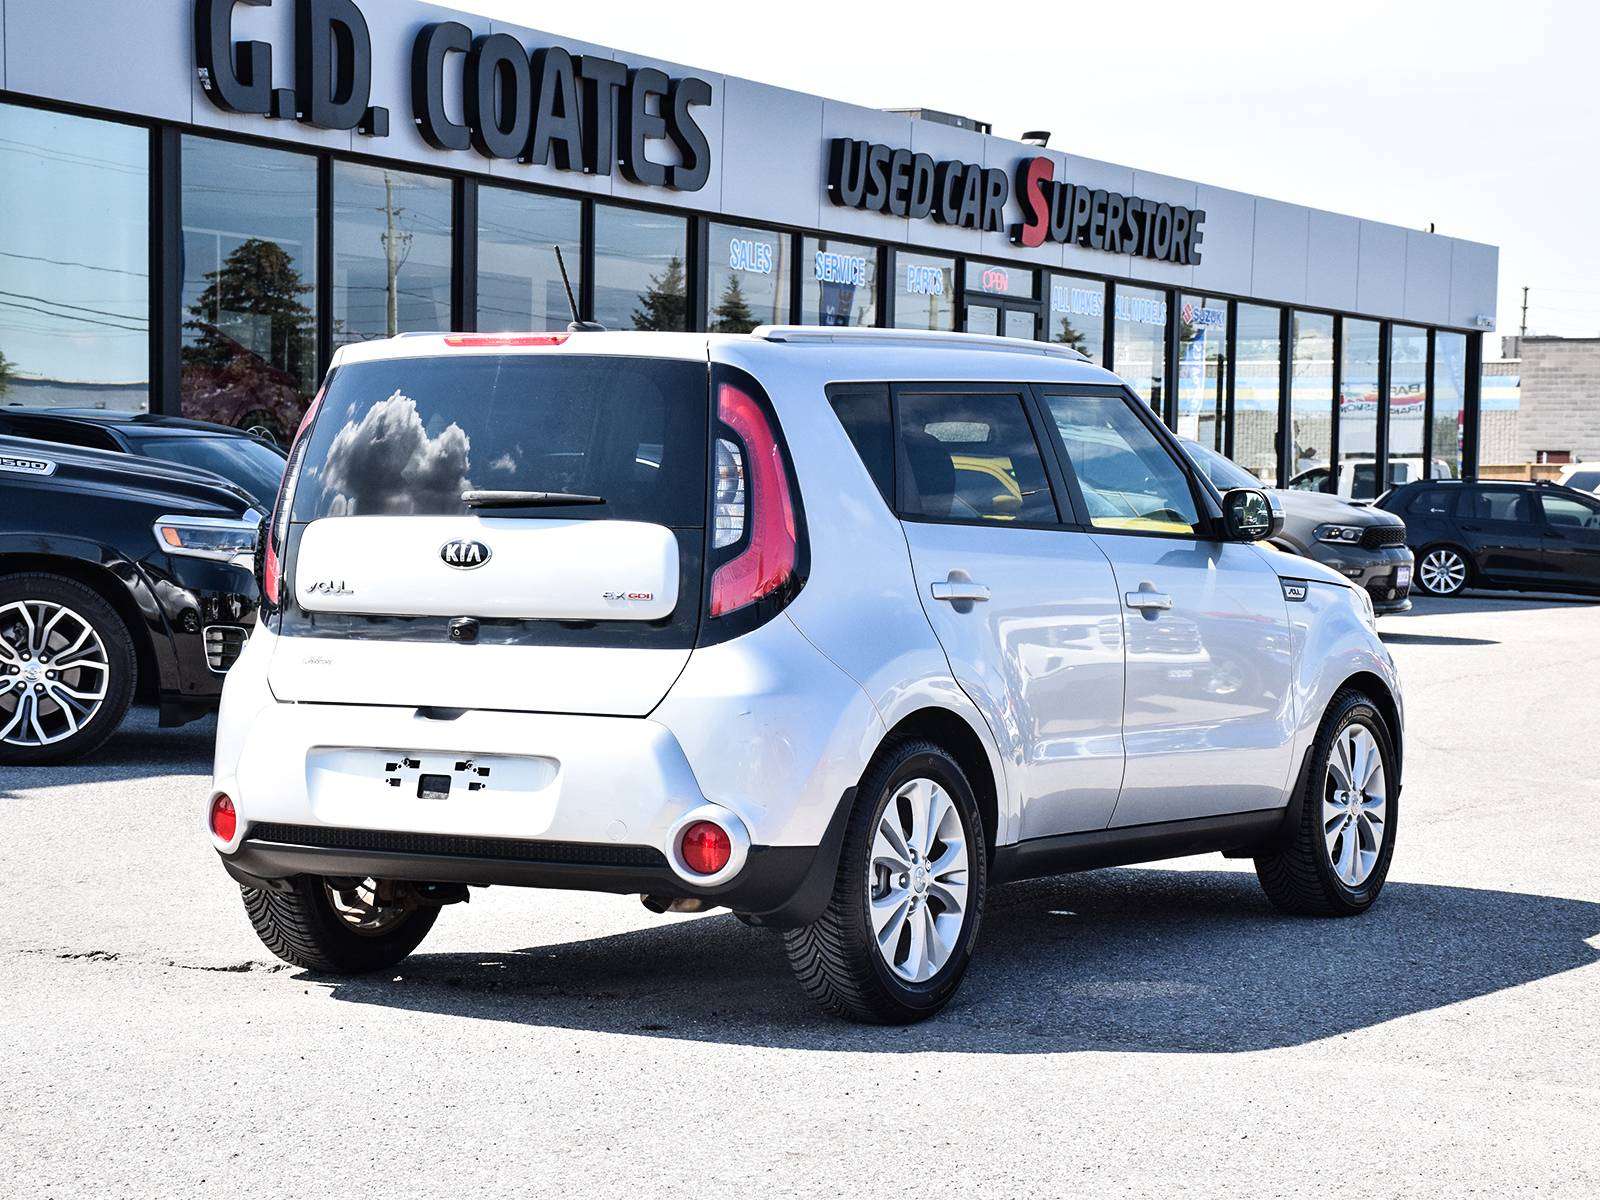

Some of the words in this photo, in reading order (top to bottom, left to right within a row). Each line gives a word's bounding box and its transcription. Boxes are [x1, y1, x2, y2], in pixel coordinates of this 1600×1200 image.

[413, 21, 712, 192] COATES
[829, 137, 935, 220] USED
[934, 160, 1009, 232] CAR
[1012, 156, 1206, 266] SUPERSTORE
[730, 238, 772, 274] SALES
[815, 251, 866, 287] SERVICE
[906, 265, 943, 296] PARTS
[982, 271, 1008, 291] OPEN
[1052, 286, 1071, 312] ALL
[1071, 288, 1102, 317] MAKES
[1114, 294, 1131, 320] ALL
[1131, 297, 1166, 326] MODELS
[446, 543, 481, 562] KIA
